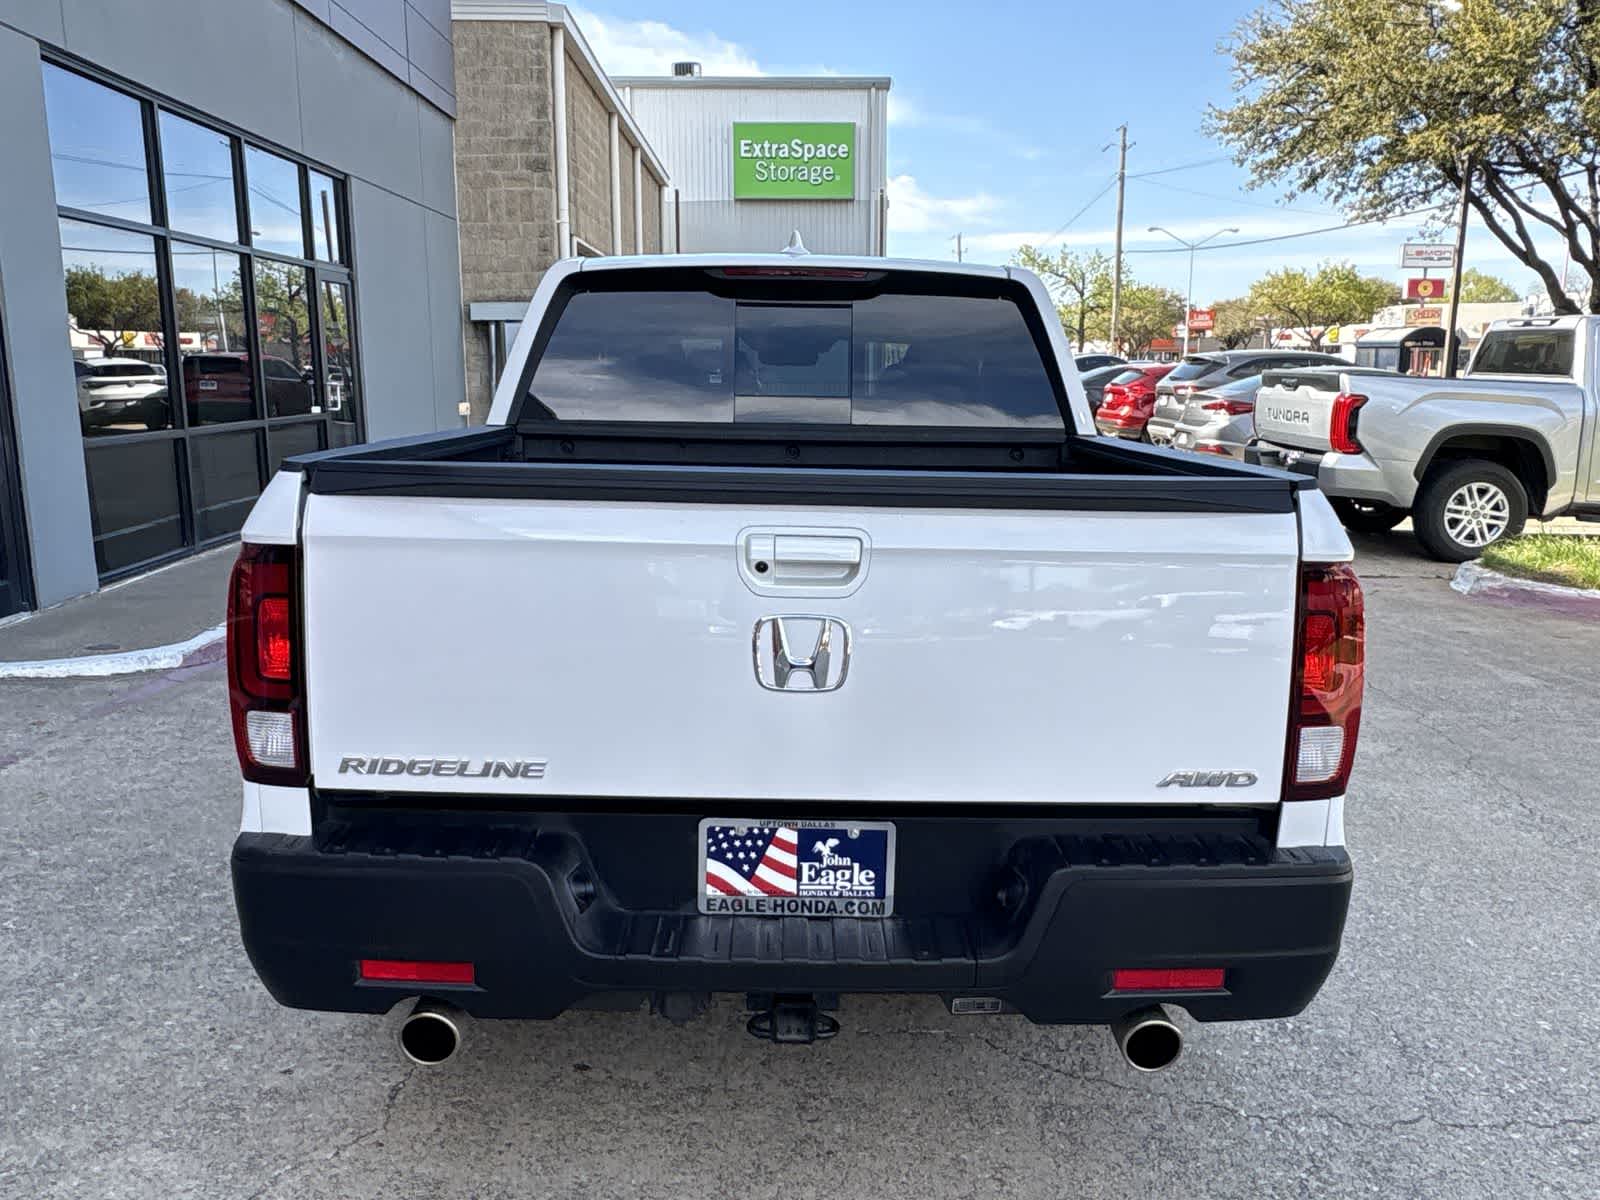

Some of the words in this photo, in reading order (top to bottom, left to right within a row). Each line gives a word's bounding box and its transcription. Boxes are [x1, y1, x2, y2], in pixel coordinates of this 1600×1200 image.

[1267, 407, 1310, 424] TUNDRA
[338, 756, 548, 779] RIDGELINE
[1156, 771, 1258, 788] AWD
[759, 820, 798, 829] UPTOWN
[801, 821, 836, 829] DALLAS
[820, 854, 852, 868] John
[799, 862, 876, 890] Eagle
